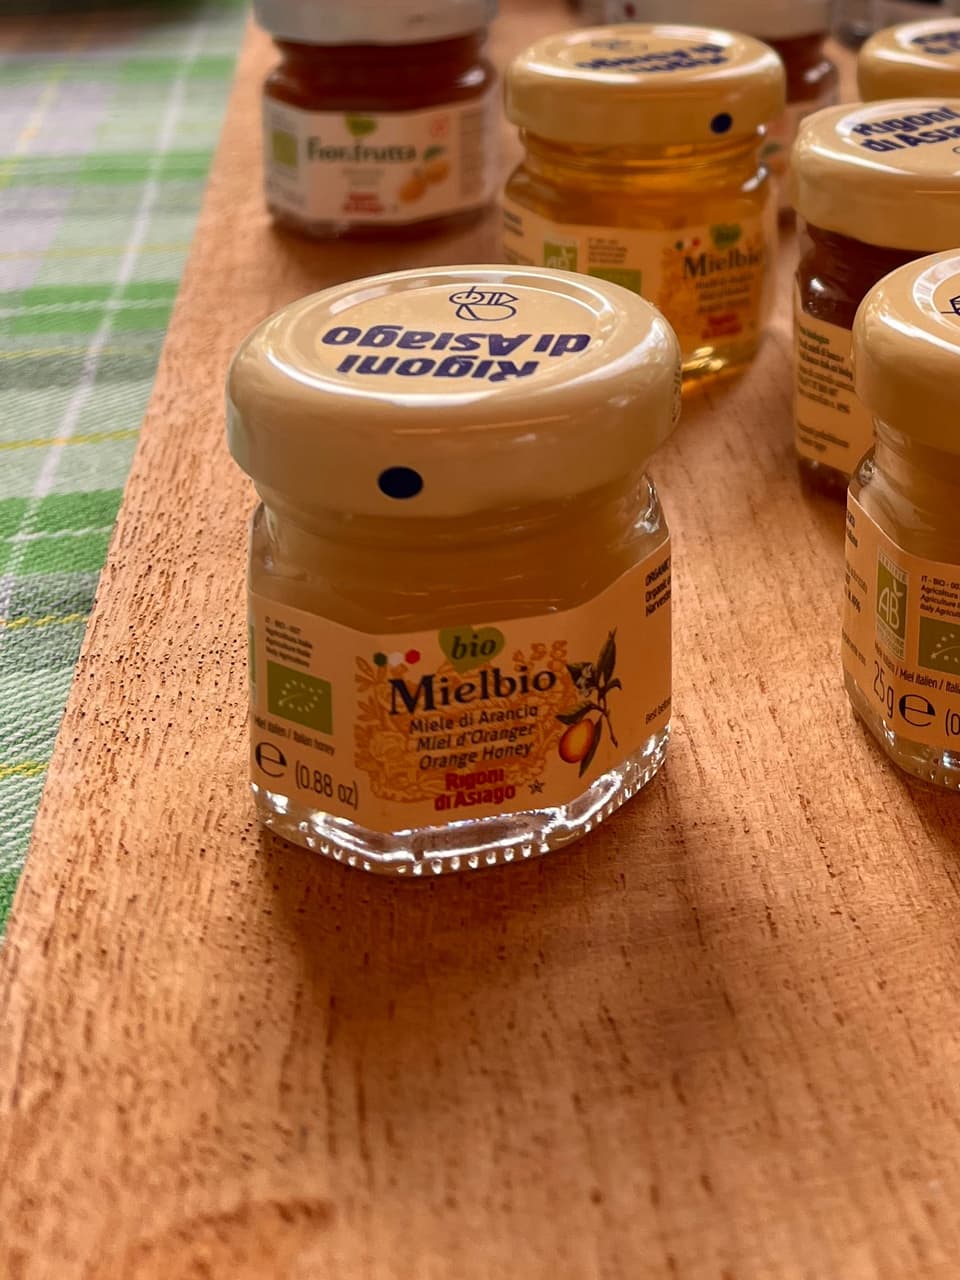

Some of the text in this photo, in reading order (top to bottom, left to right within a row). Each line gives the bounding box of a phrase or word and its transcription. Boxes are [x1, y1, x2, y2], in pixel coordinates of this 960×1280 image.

[860, 138, 907, 152] di
[321, 325, 591, 357] di Asiago
[336, 354, 539, 382] Rigoni
[878, 586, 903, 630] AB
[452, 634, 496, 660] bio
[900, 668, 914, 682] Miel
[388, 664, 557, 716] Mielbio
[874, 660, 885, 703] 25
[887, 686, 894, 719] g
[409, 704, 538, 734] Miele di Arancio
[416, 735, 450, 752] Miel
[419, 741, 535, 770] Orange Honey
[296, 760, 333, 798] (0.88
[338, 780, 358, 810] oz)
[445, 768, 505, 791] Rigoni
[434, 785, 516, 811] di Asiago
